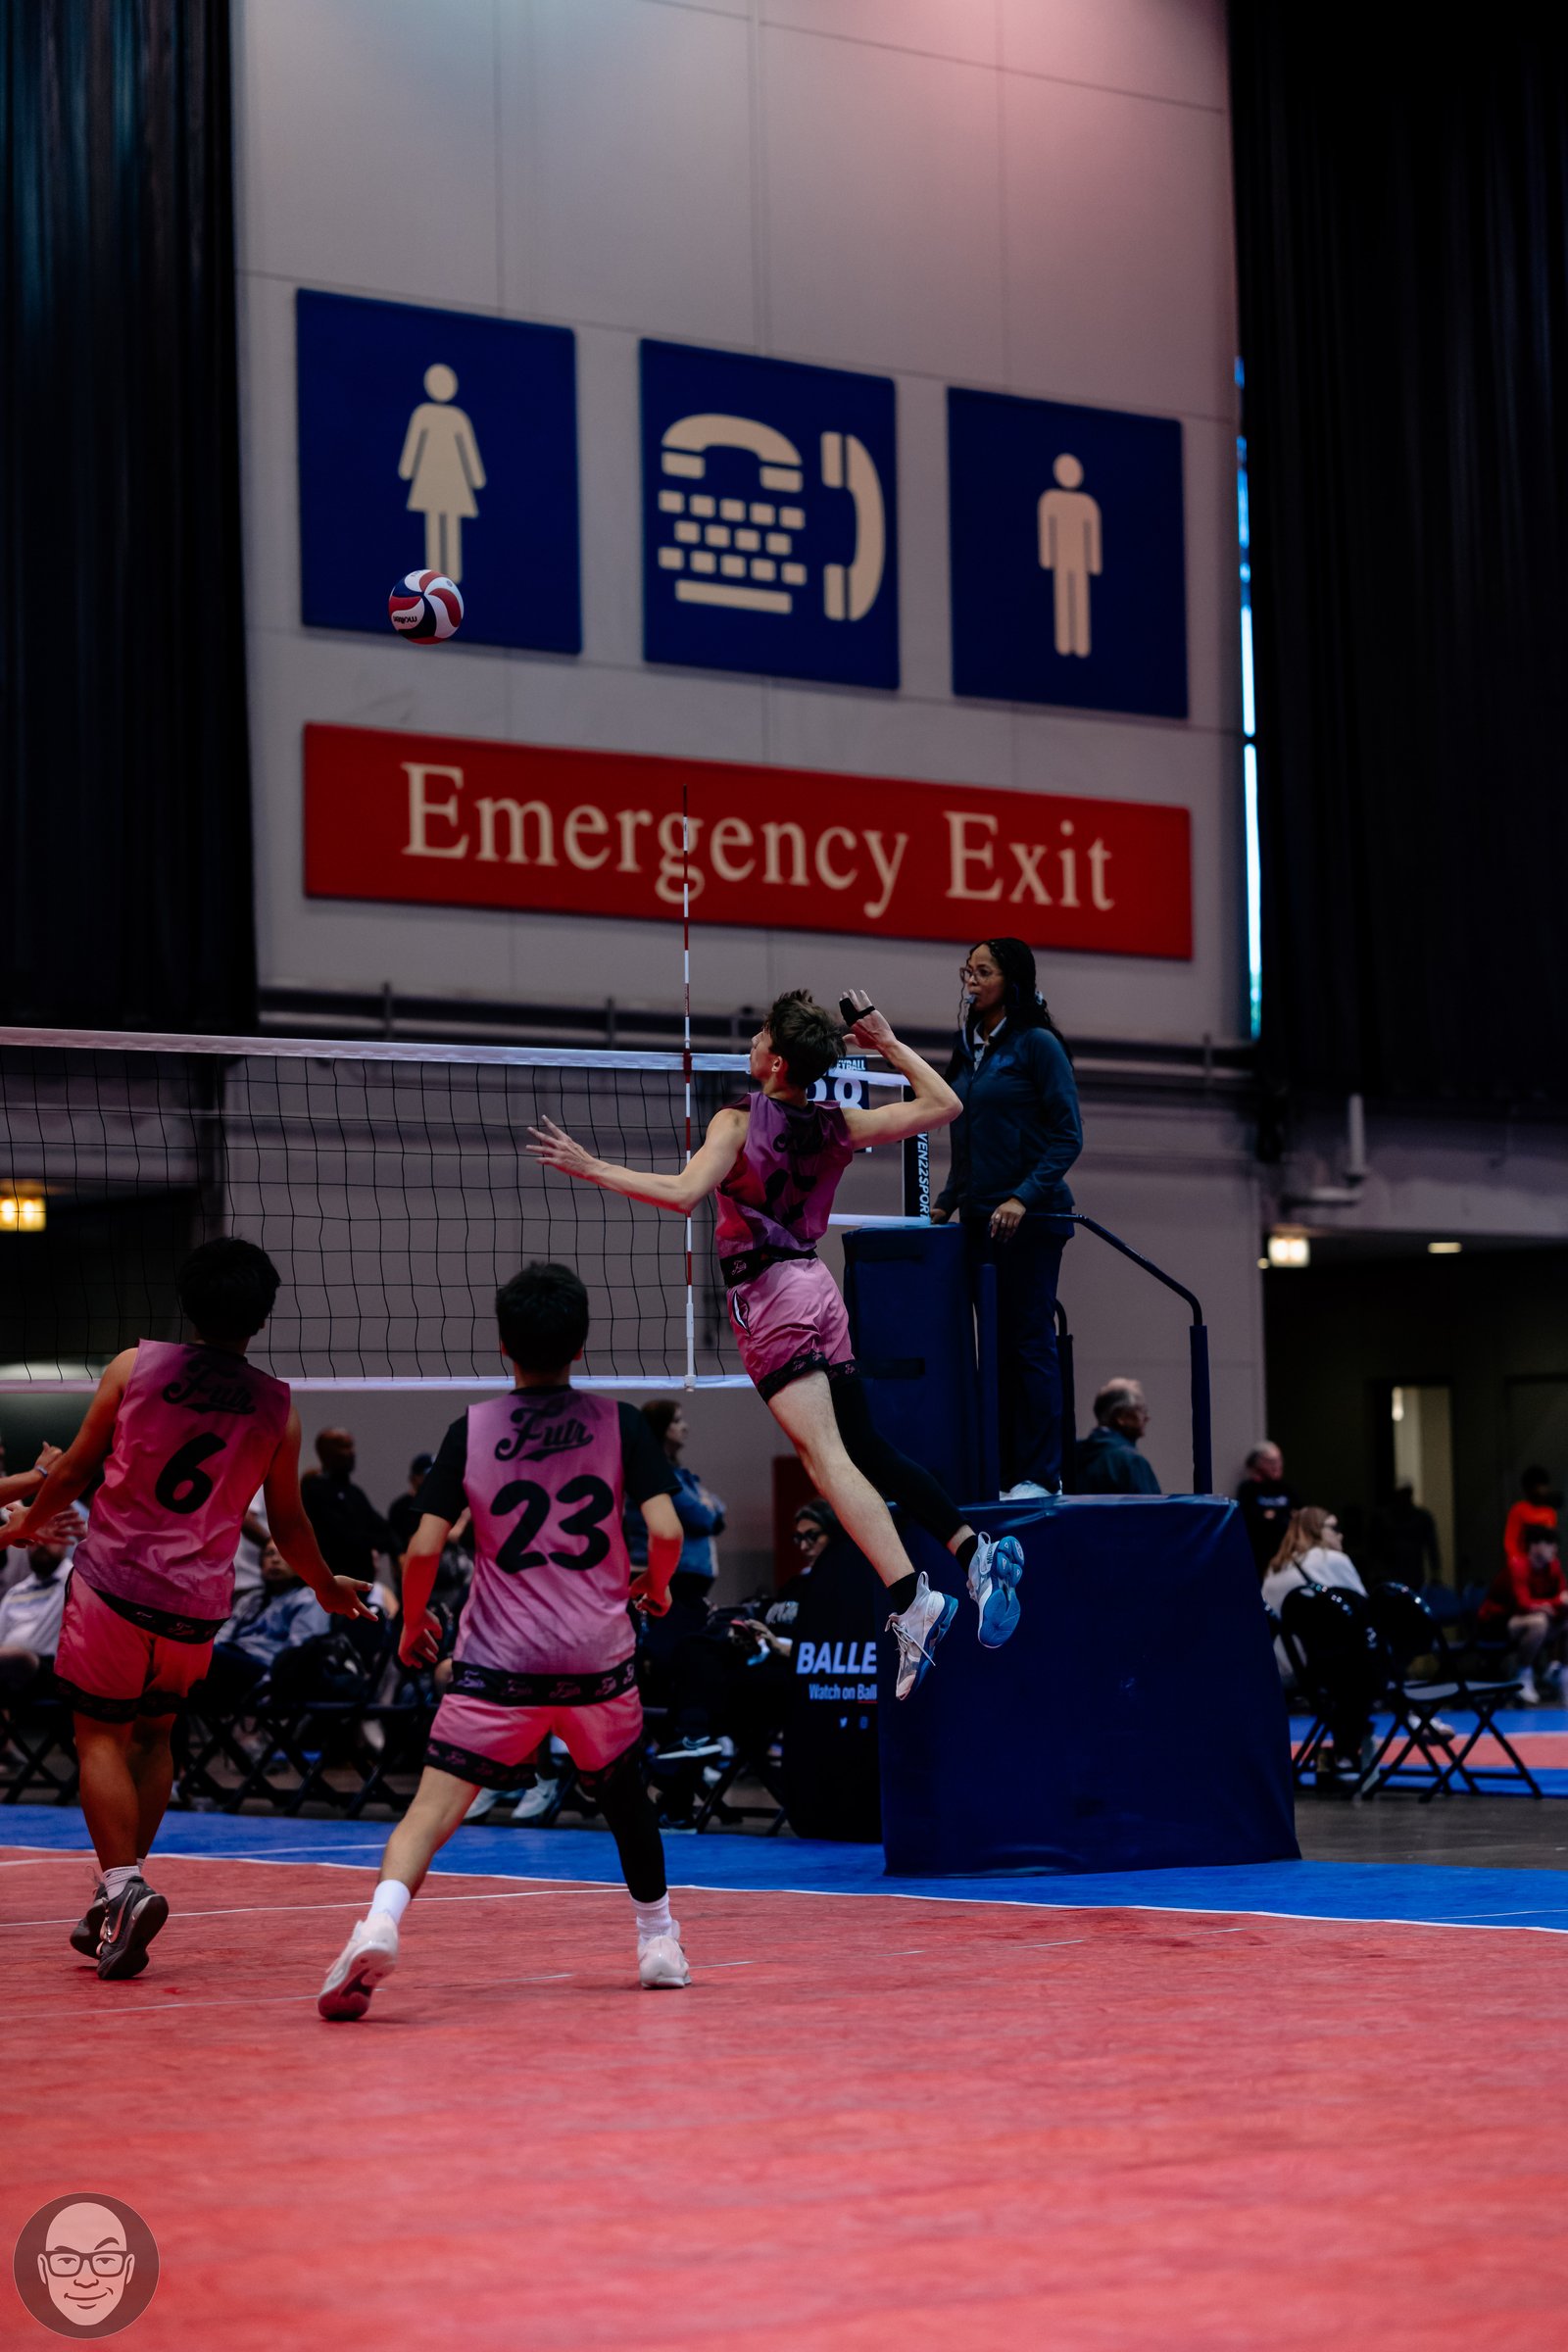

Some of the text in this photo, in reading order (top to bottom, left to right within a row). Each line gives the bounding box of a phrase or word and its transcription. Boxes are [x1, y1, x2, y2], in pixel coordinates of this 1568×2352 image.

[401, 760, 1115, 919] Emergency Exit
[155, 1432, 227, 1514] 6
[491, 1475, 614, 1574] 23
[808, 1683, 841, 1700] Watch
[842, 1687, 856, 1700] on
